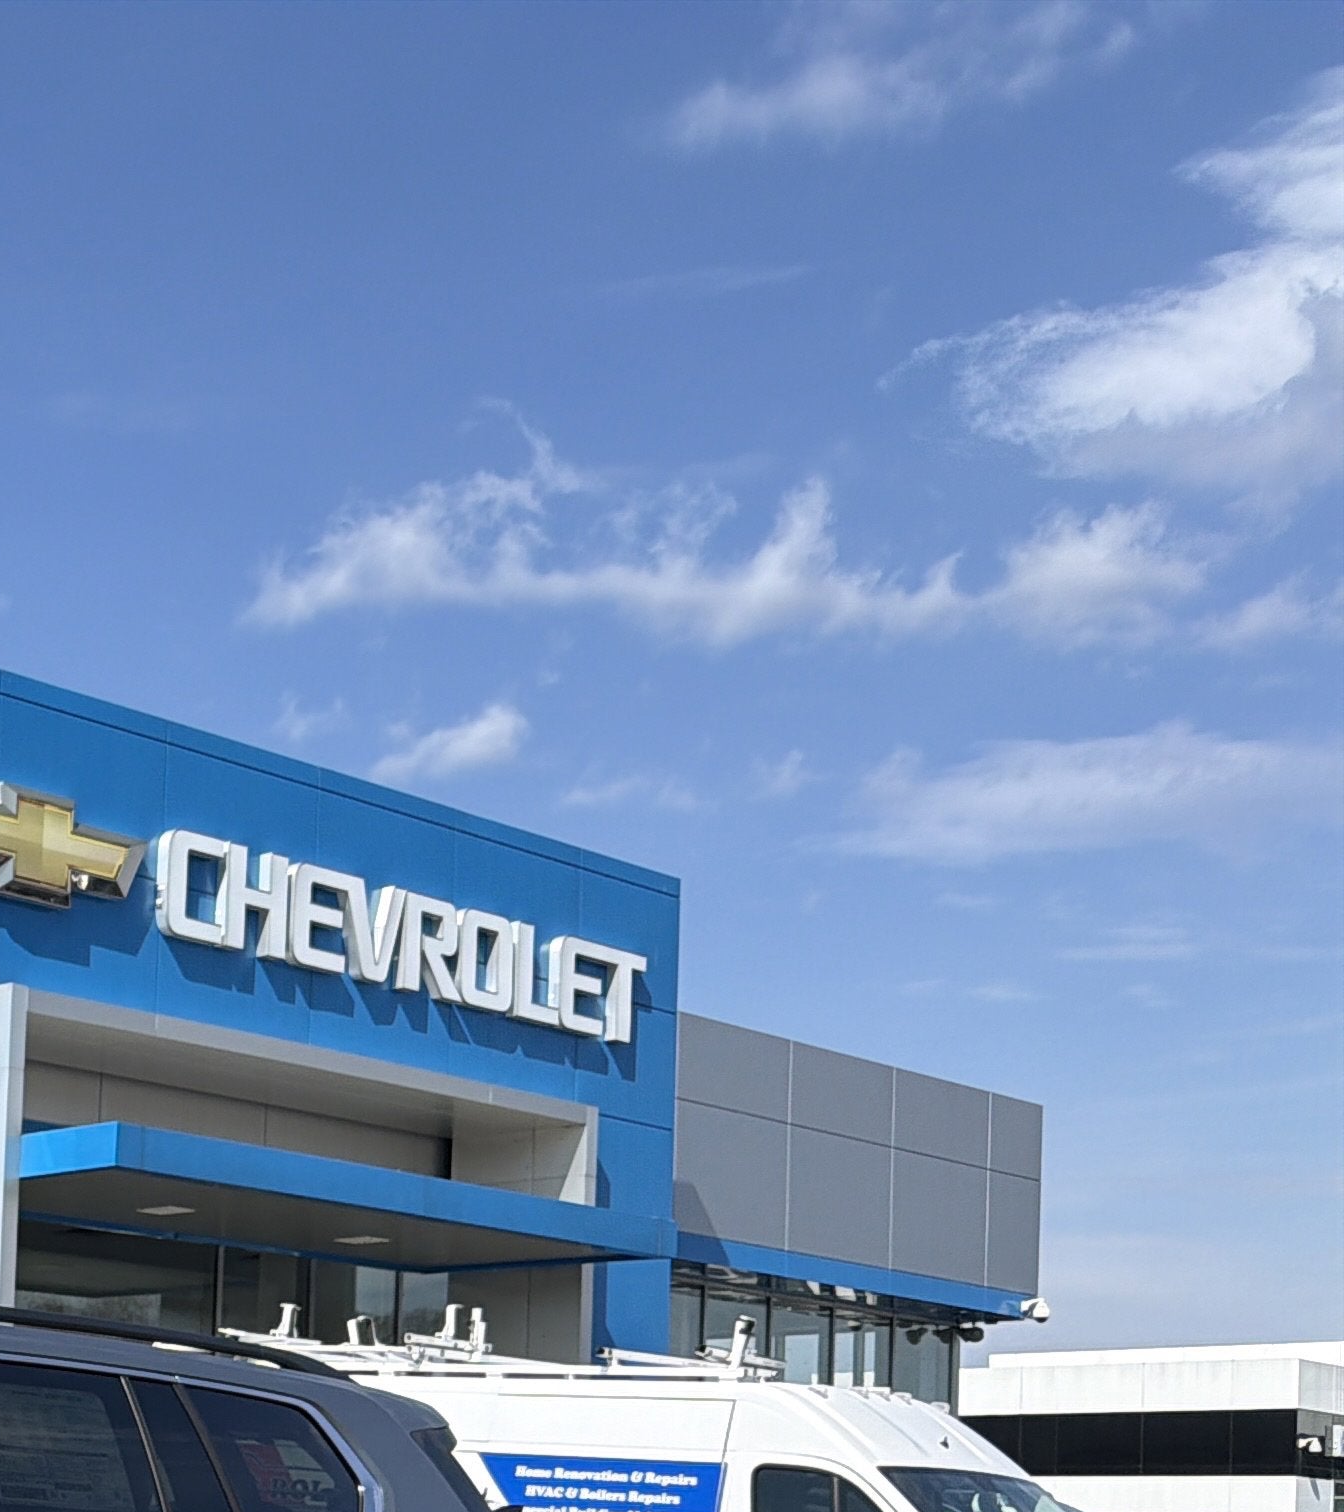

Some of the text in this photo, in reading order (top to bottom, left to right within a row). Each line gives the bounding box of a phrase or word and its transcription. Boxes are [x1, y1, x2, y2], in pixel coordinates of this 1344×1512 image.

[156, 829, 647, 1044] CHEVROLET
[515, 1465, 698, 1487] Home Renovation & Repairs
[525, 1485, 681, 1506] HVAC & Boilers Repairs
